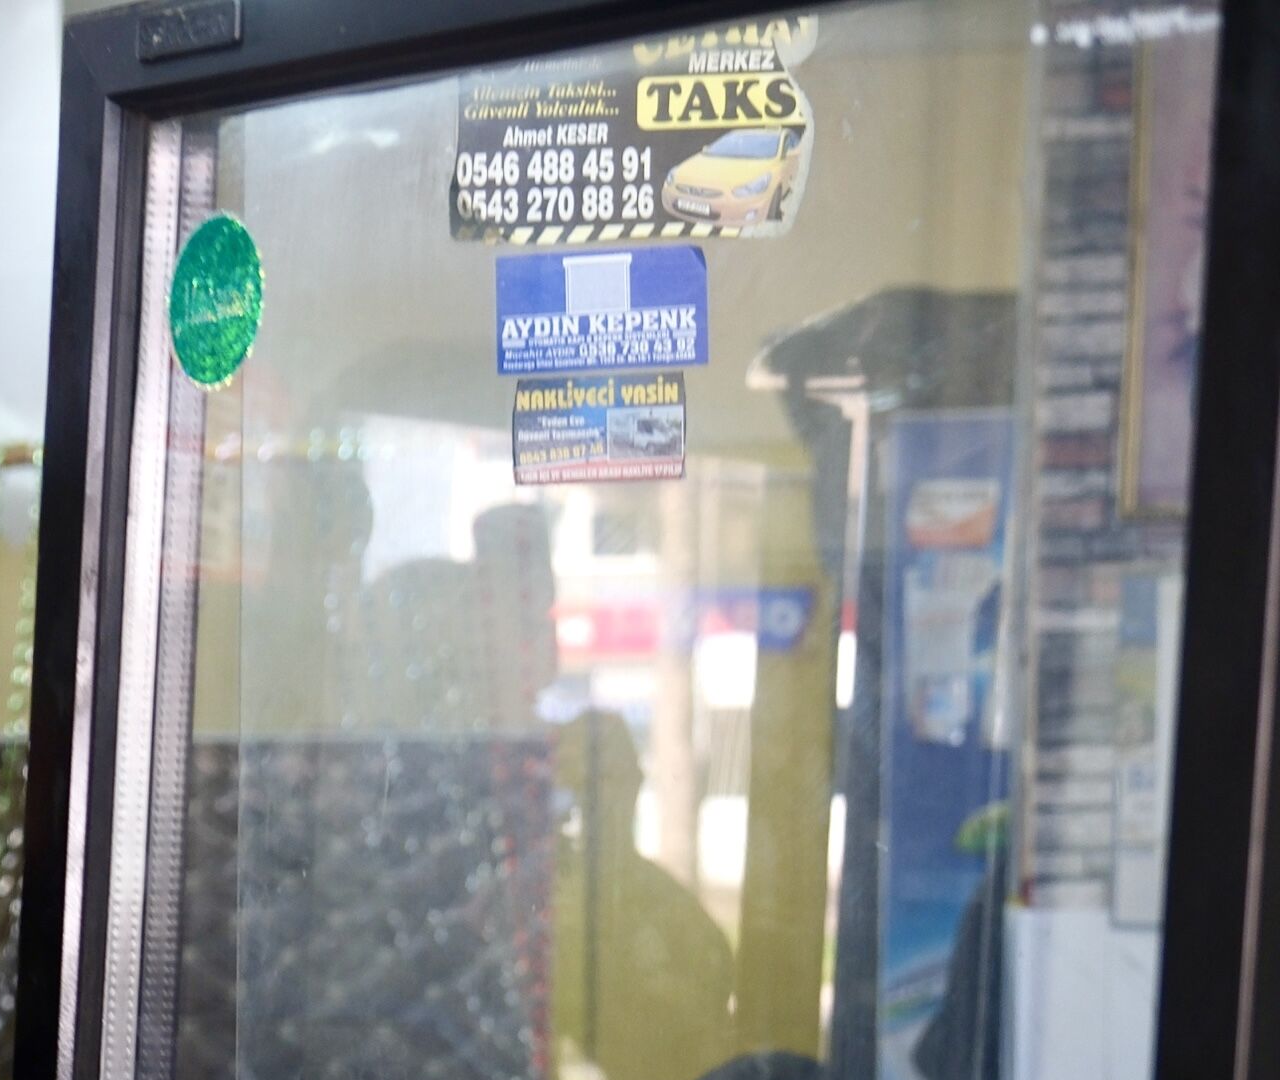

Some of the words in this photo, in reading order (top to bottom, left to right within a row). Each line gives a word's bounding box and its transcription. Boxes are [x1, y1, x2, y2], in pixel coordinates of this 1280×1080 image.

[689, 50, 775, 73] MERKEZ
[646, 79, 804, 122] TAKS
[503, 125, 553, 148] Ahmet
[557, 122, 609, 145] KESER
[456, 152, 520, 188] 0546
[526, 148, 575, 186] 488
[582, 147, 615, 182] 45
[621, 146, 653, 181] 91
[457, 188, 520, 224] 0543
[526, 186, 575, 222] 270
[581, 184, 615, 221] 88
[621, 183, 655, 220] 26
[502, 315, 580, 339] AYDIN
[590, 306, 697, 335] KEPENK
[621, 375, 679, 405] YASİN
